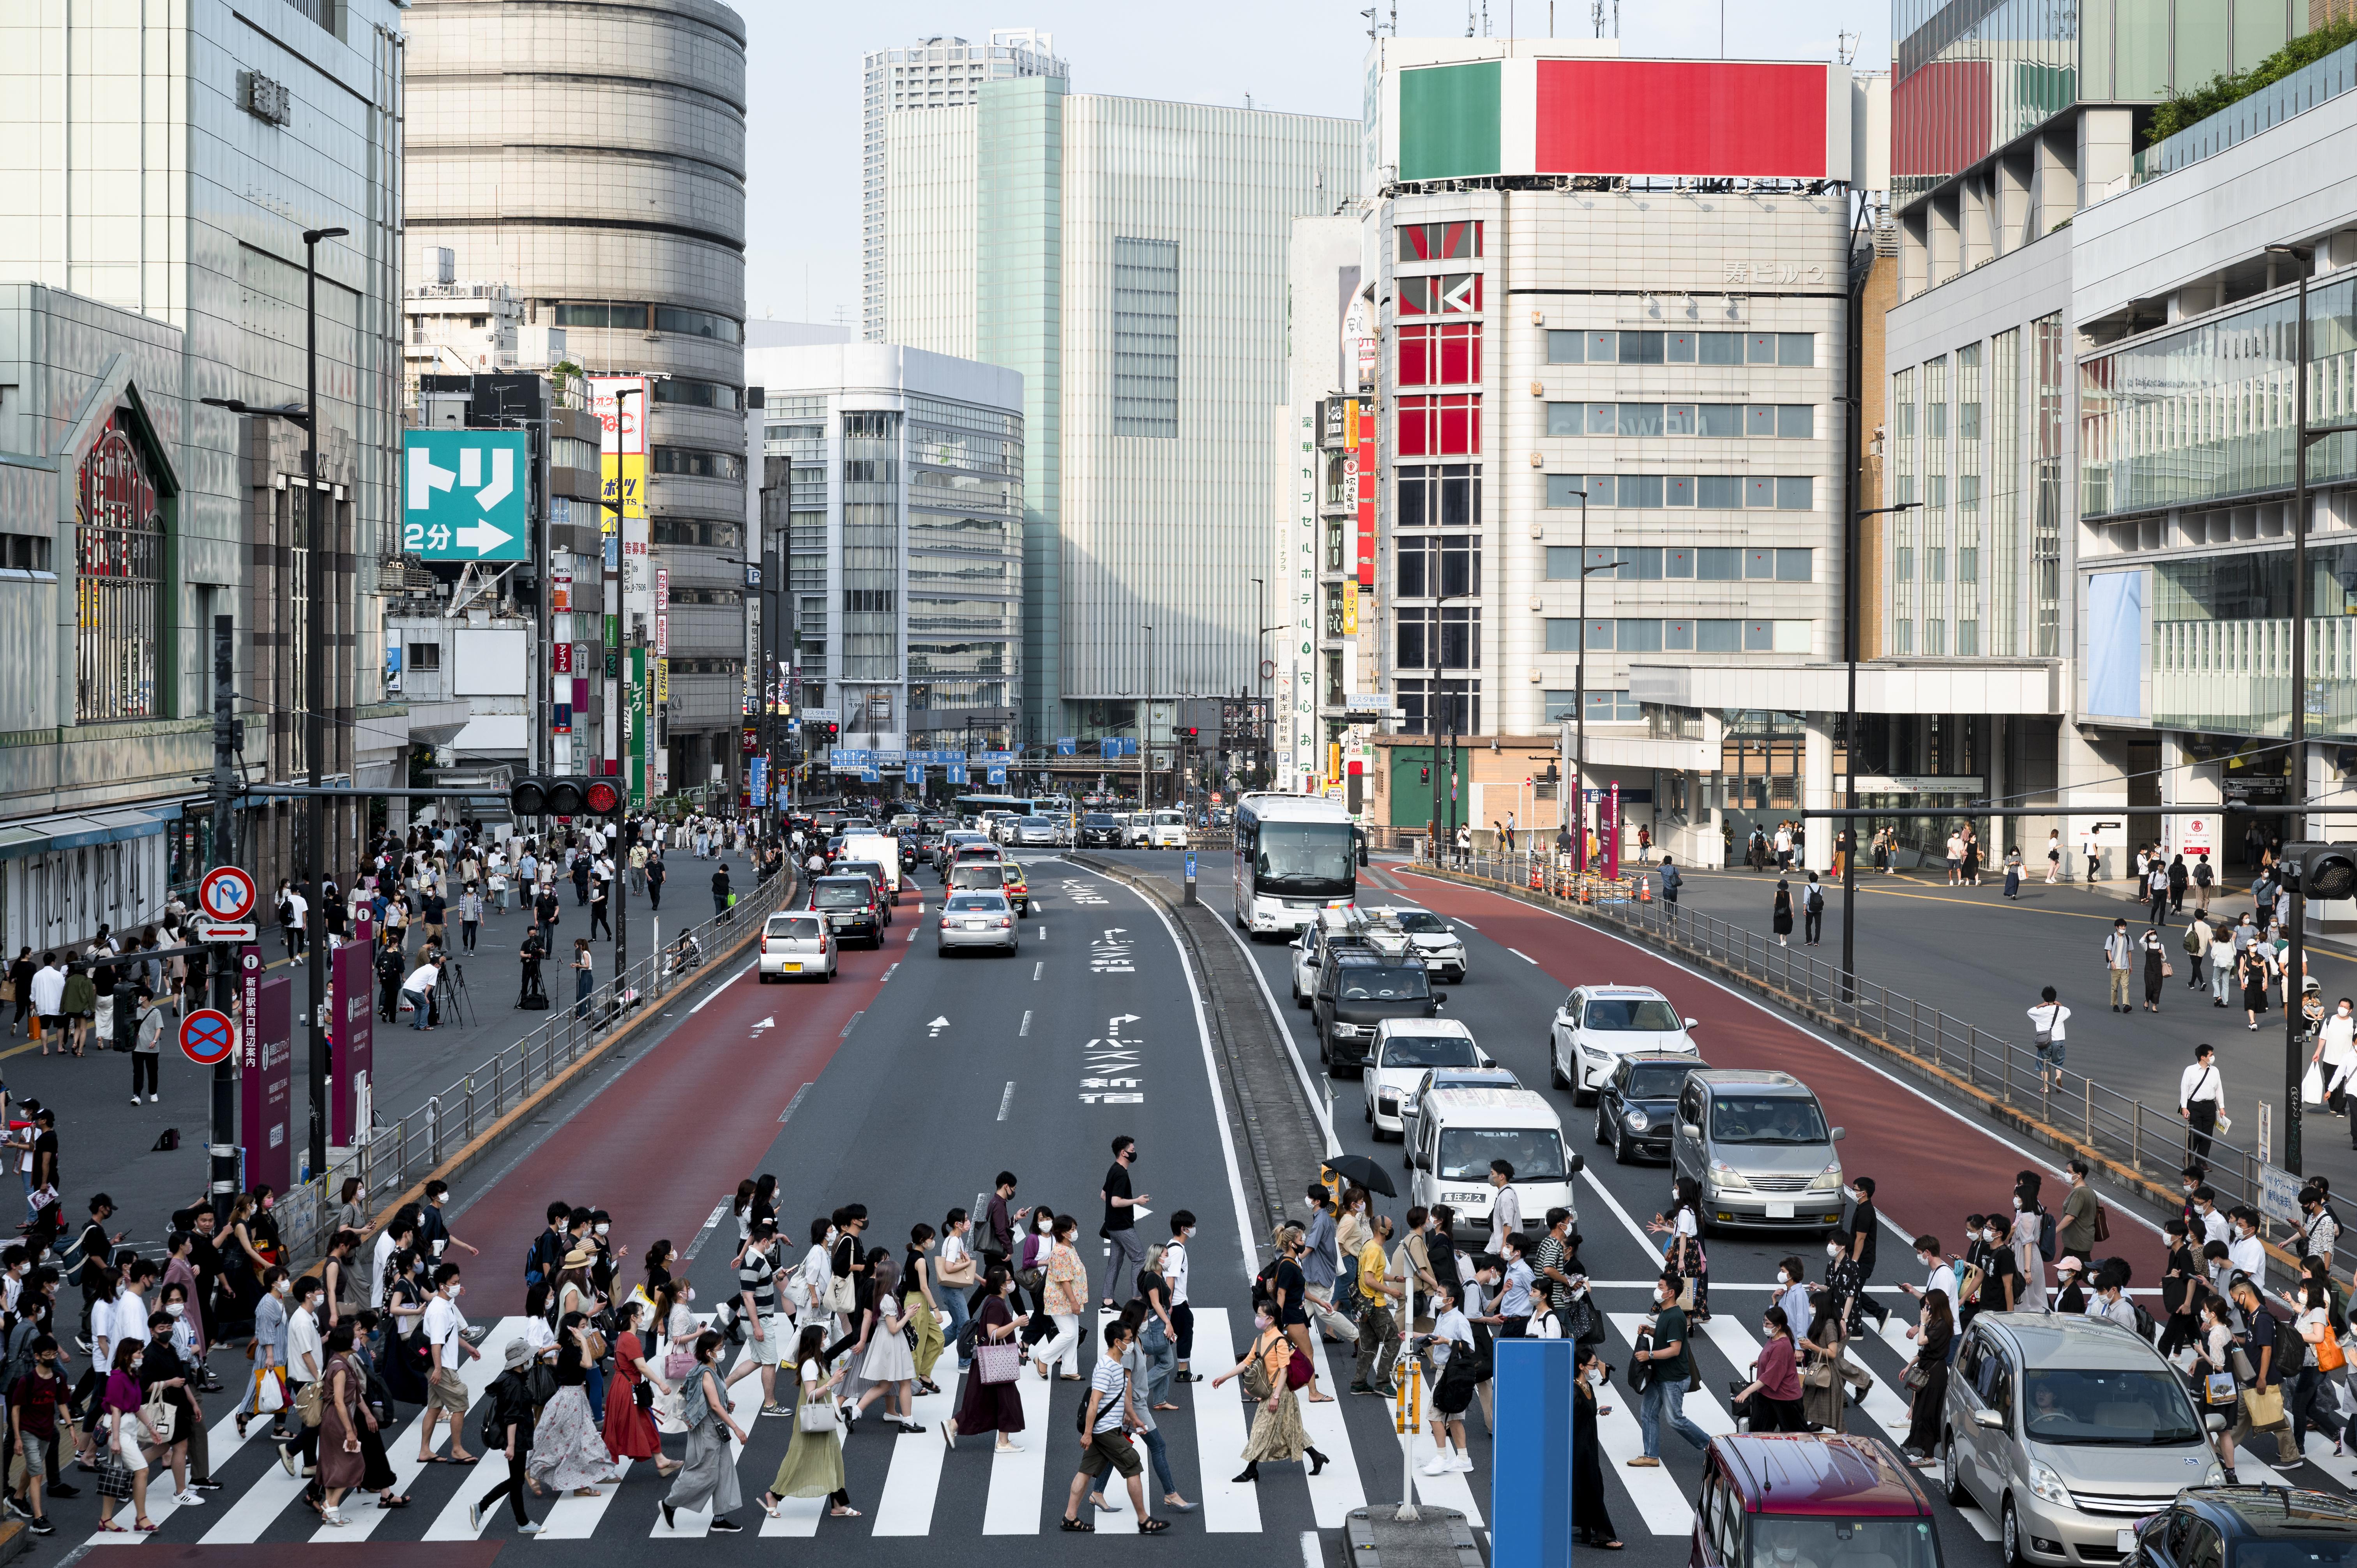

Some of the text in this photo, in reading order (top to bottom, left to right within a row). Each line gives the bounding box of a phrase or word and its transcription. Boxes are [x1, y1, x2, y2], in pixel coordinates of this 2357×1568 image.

[1349, 411, 1357, 437] 鳥貴族
[408, 448, 513, 512] トリ
[1346, 478, 1356, 510] 塚田農場
[405, 523, 451, 550] 2分
[1302, 417, 1313, 629] 豪華カプセルホテル
[623, 542, 647, 555] 告募集
[607, 655, 616, 677] ウッド
[632, 682, 642, 712] レイク
[93, 837, 145, 923] SPECIAL
[246, 977, 256, 1067] 新宿駅南口周辺案内
[1444, 1193, 1482, 1202] 高圧ガス
